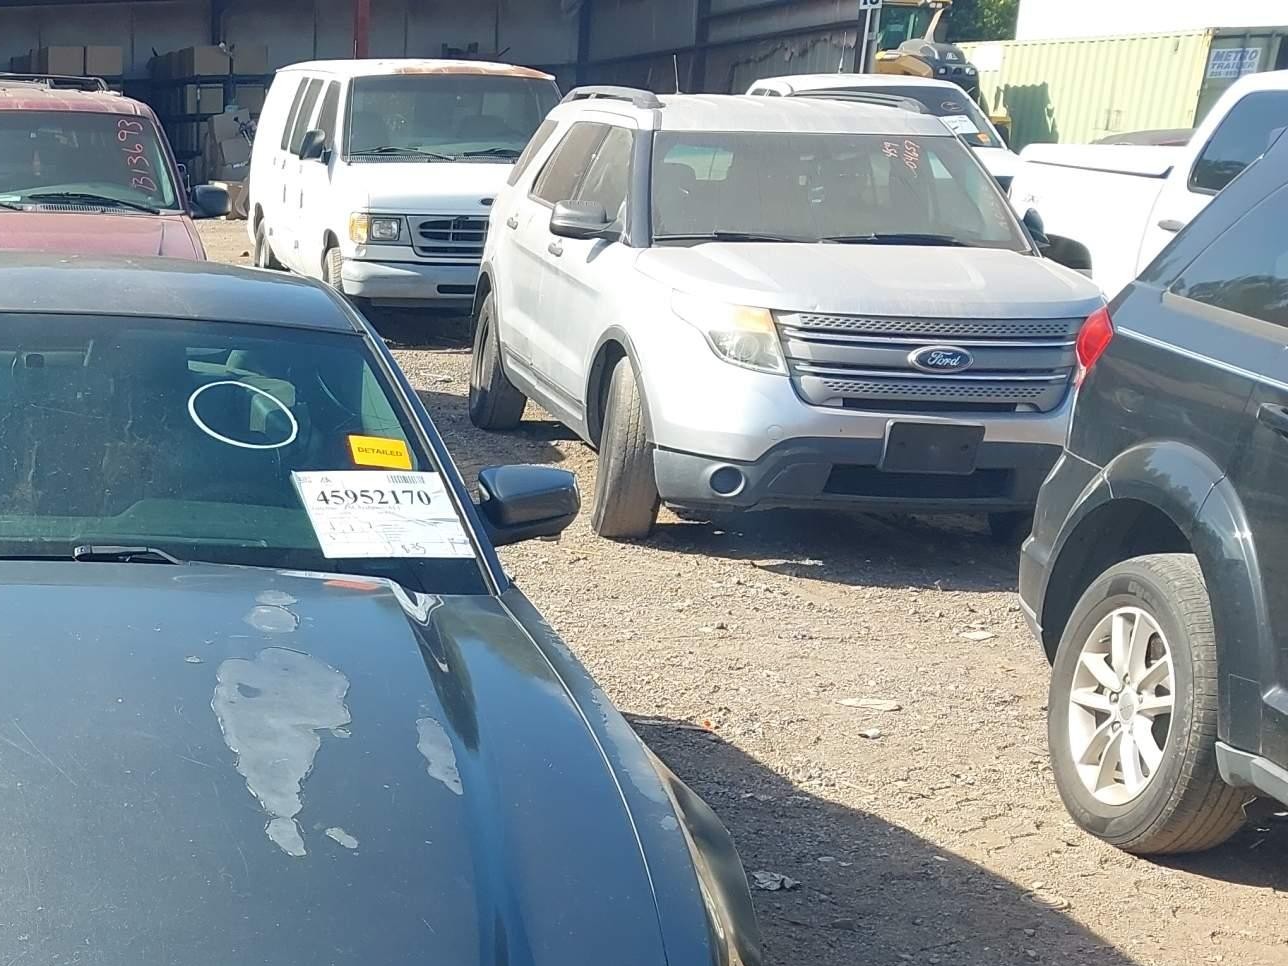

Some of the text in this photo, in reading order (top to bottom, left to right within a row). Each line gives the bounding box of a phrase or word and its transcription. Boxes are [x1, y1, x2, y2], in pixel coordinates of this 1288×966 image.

[1212, 49, 1259, 61] METRO
[117, 119, 158, 192] B13693
[927, 350, 961, 366] Ford
[357, 446, 403, 457] DETAILED
[316, 489, 432, 506] 45952170
